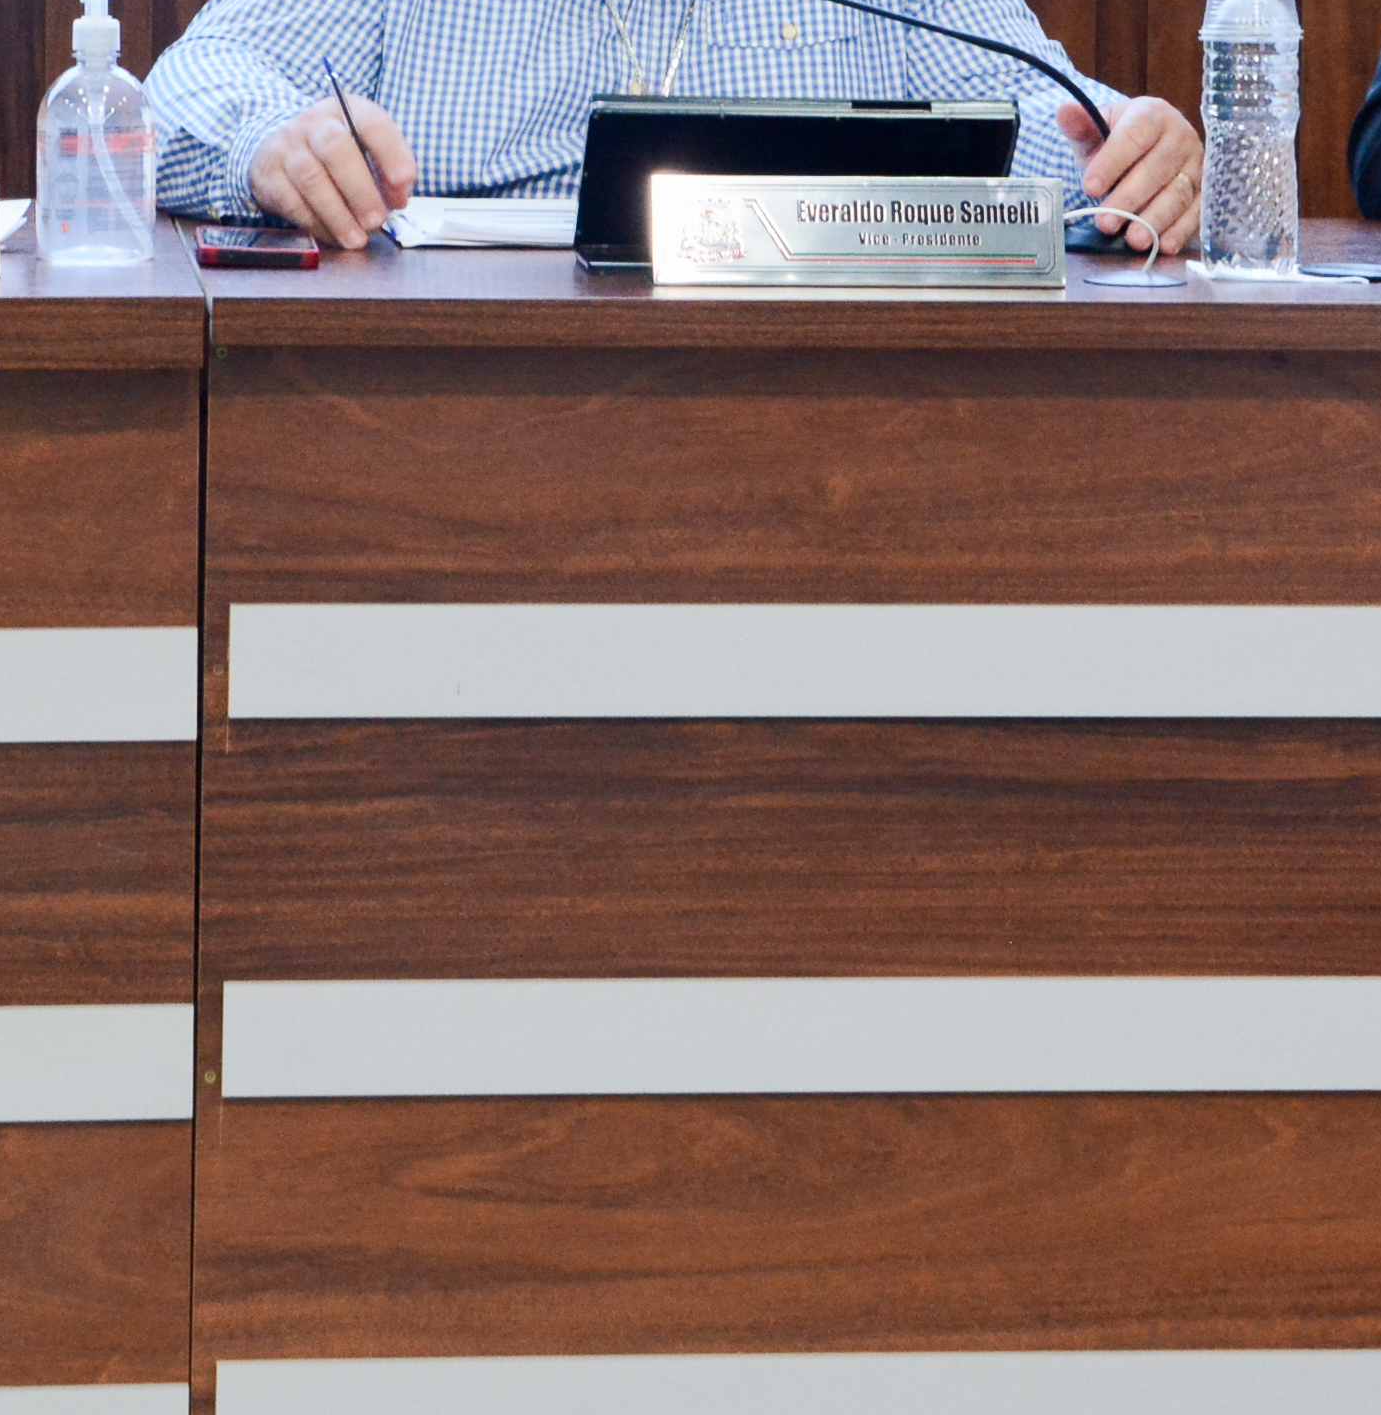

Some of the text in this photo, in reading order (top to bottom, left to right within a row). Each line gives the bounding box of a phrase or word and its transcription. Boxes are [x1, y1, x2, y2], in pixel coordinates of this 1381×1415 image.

[797, 200, 1040, 225] Everaldo Roque Santelli
[858, 232, 889, 245] Vice
[902, 233, 981, 246] Presidente
